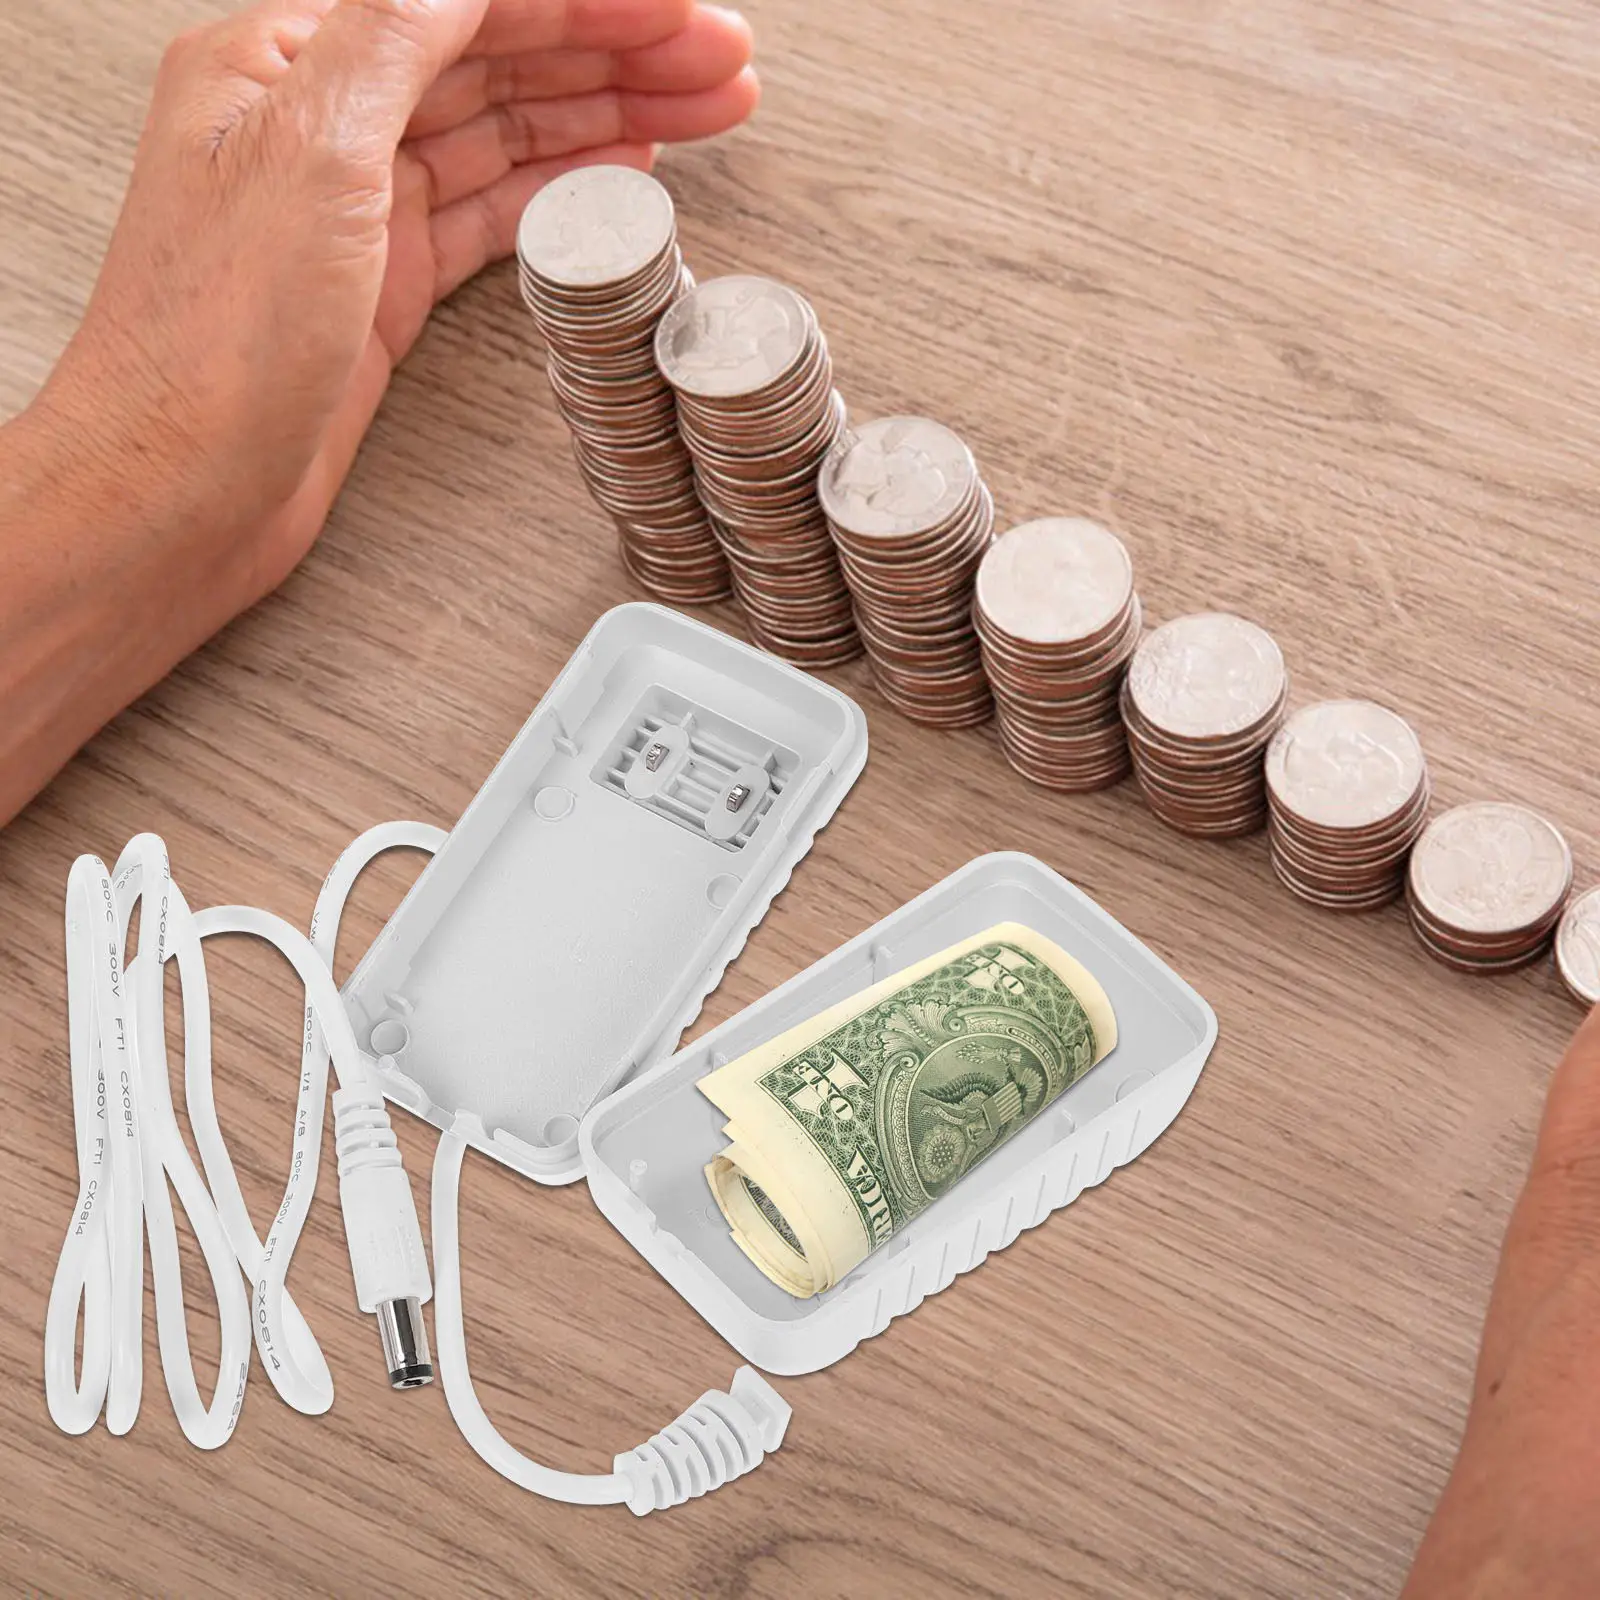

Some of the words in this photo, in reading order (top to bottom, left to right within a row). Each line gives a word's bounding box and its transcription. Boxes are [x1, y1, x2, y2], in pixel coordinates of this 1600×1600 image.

[108, 943, 120, 997] 300V
[96, 1069, 106, 1120] 300V
[792, 1060, 855, 1121] ONE
[276, 1192, 294, 1225] 300V
